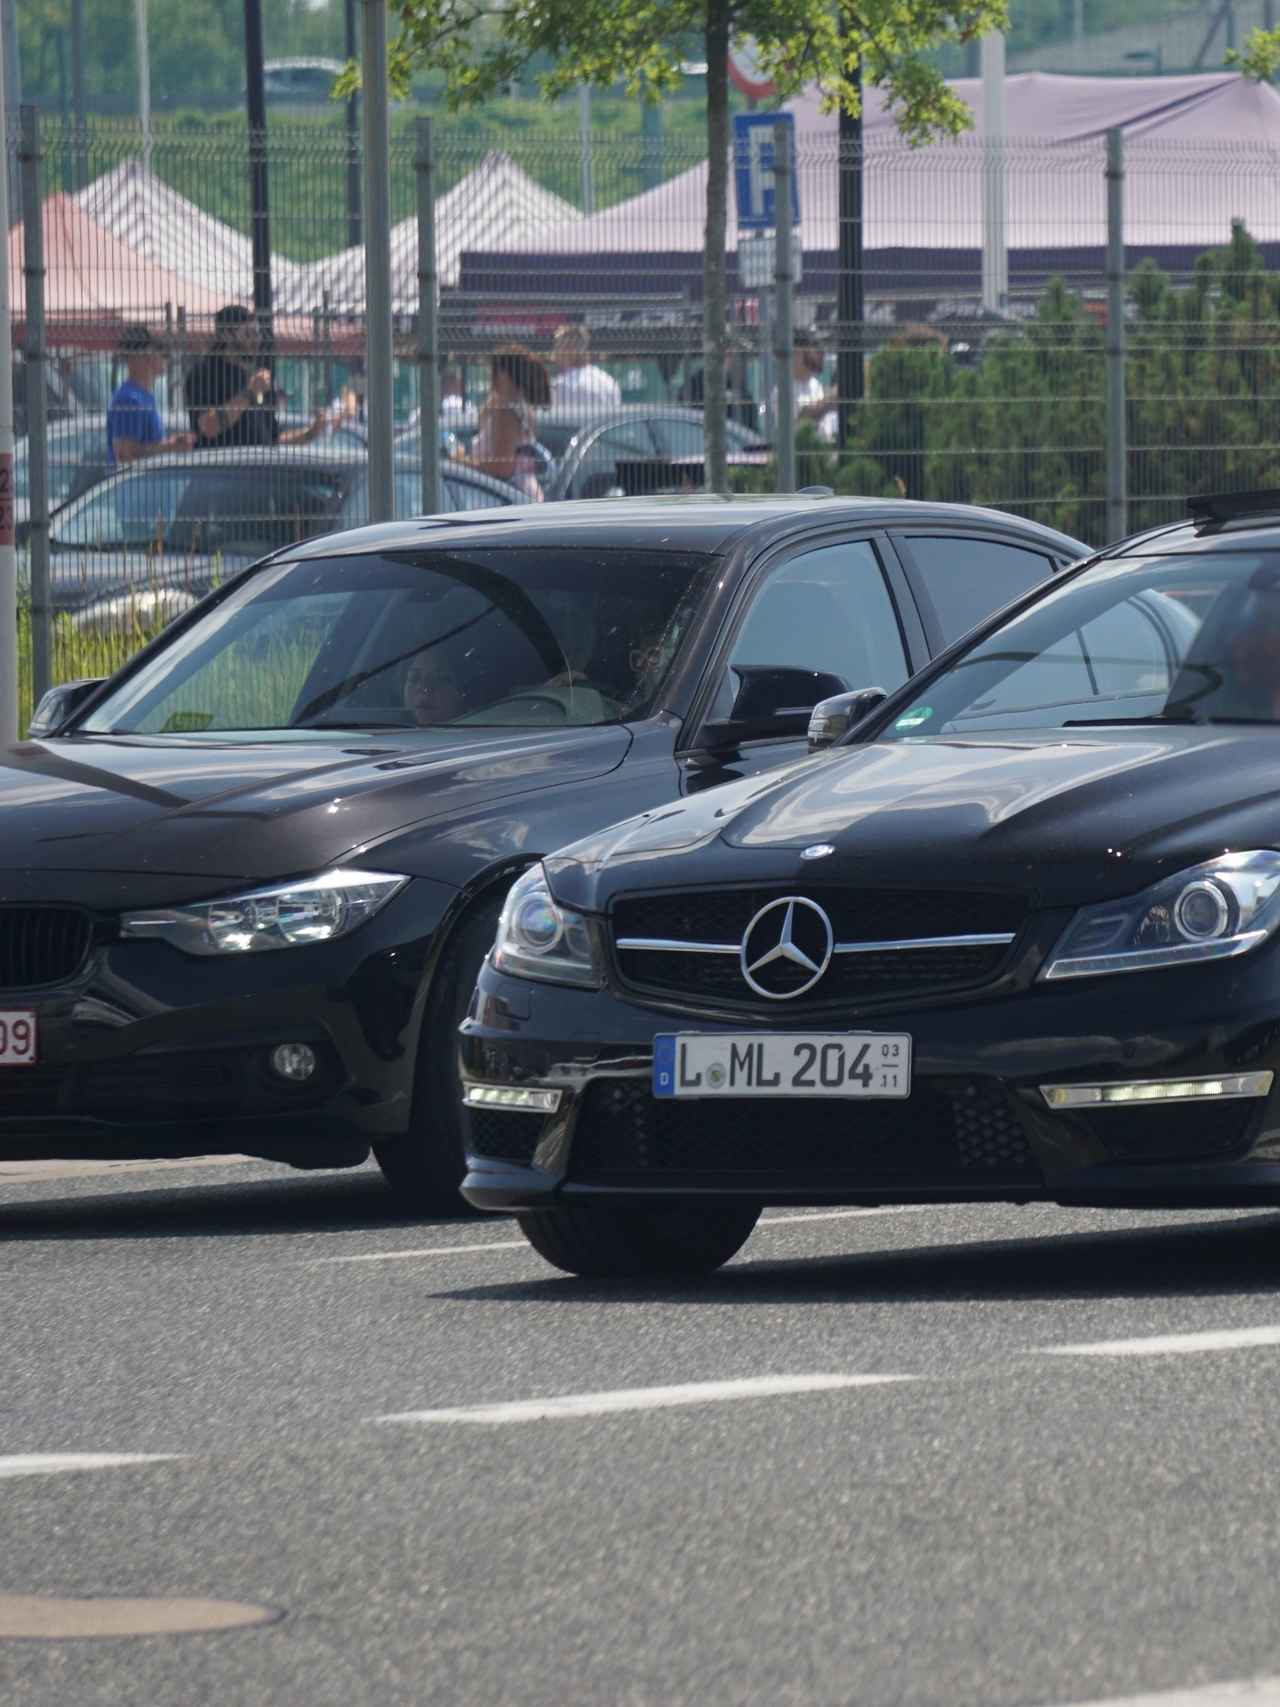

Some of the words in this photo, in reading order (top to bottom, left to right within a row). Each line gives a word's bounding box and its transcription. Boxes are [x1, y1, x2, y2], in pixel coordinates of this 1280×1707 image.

[660, 1072, 669, 1086] D
[679, 1043, 702, 1088] L
[729, 1043, 780, 1088] ML
[791, 1043, 873, 1088] 204
[882, 1074, 897, 1088] 11
